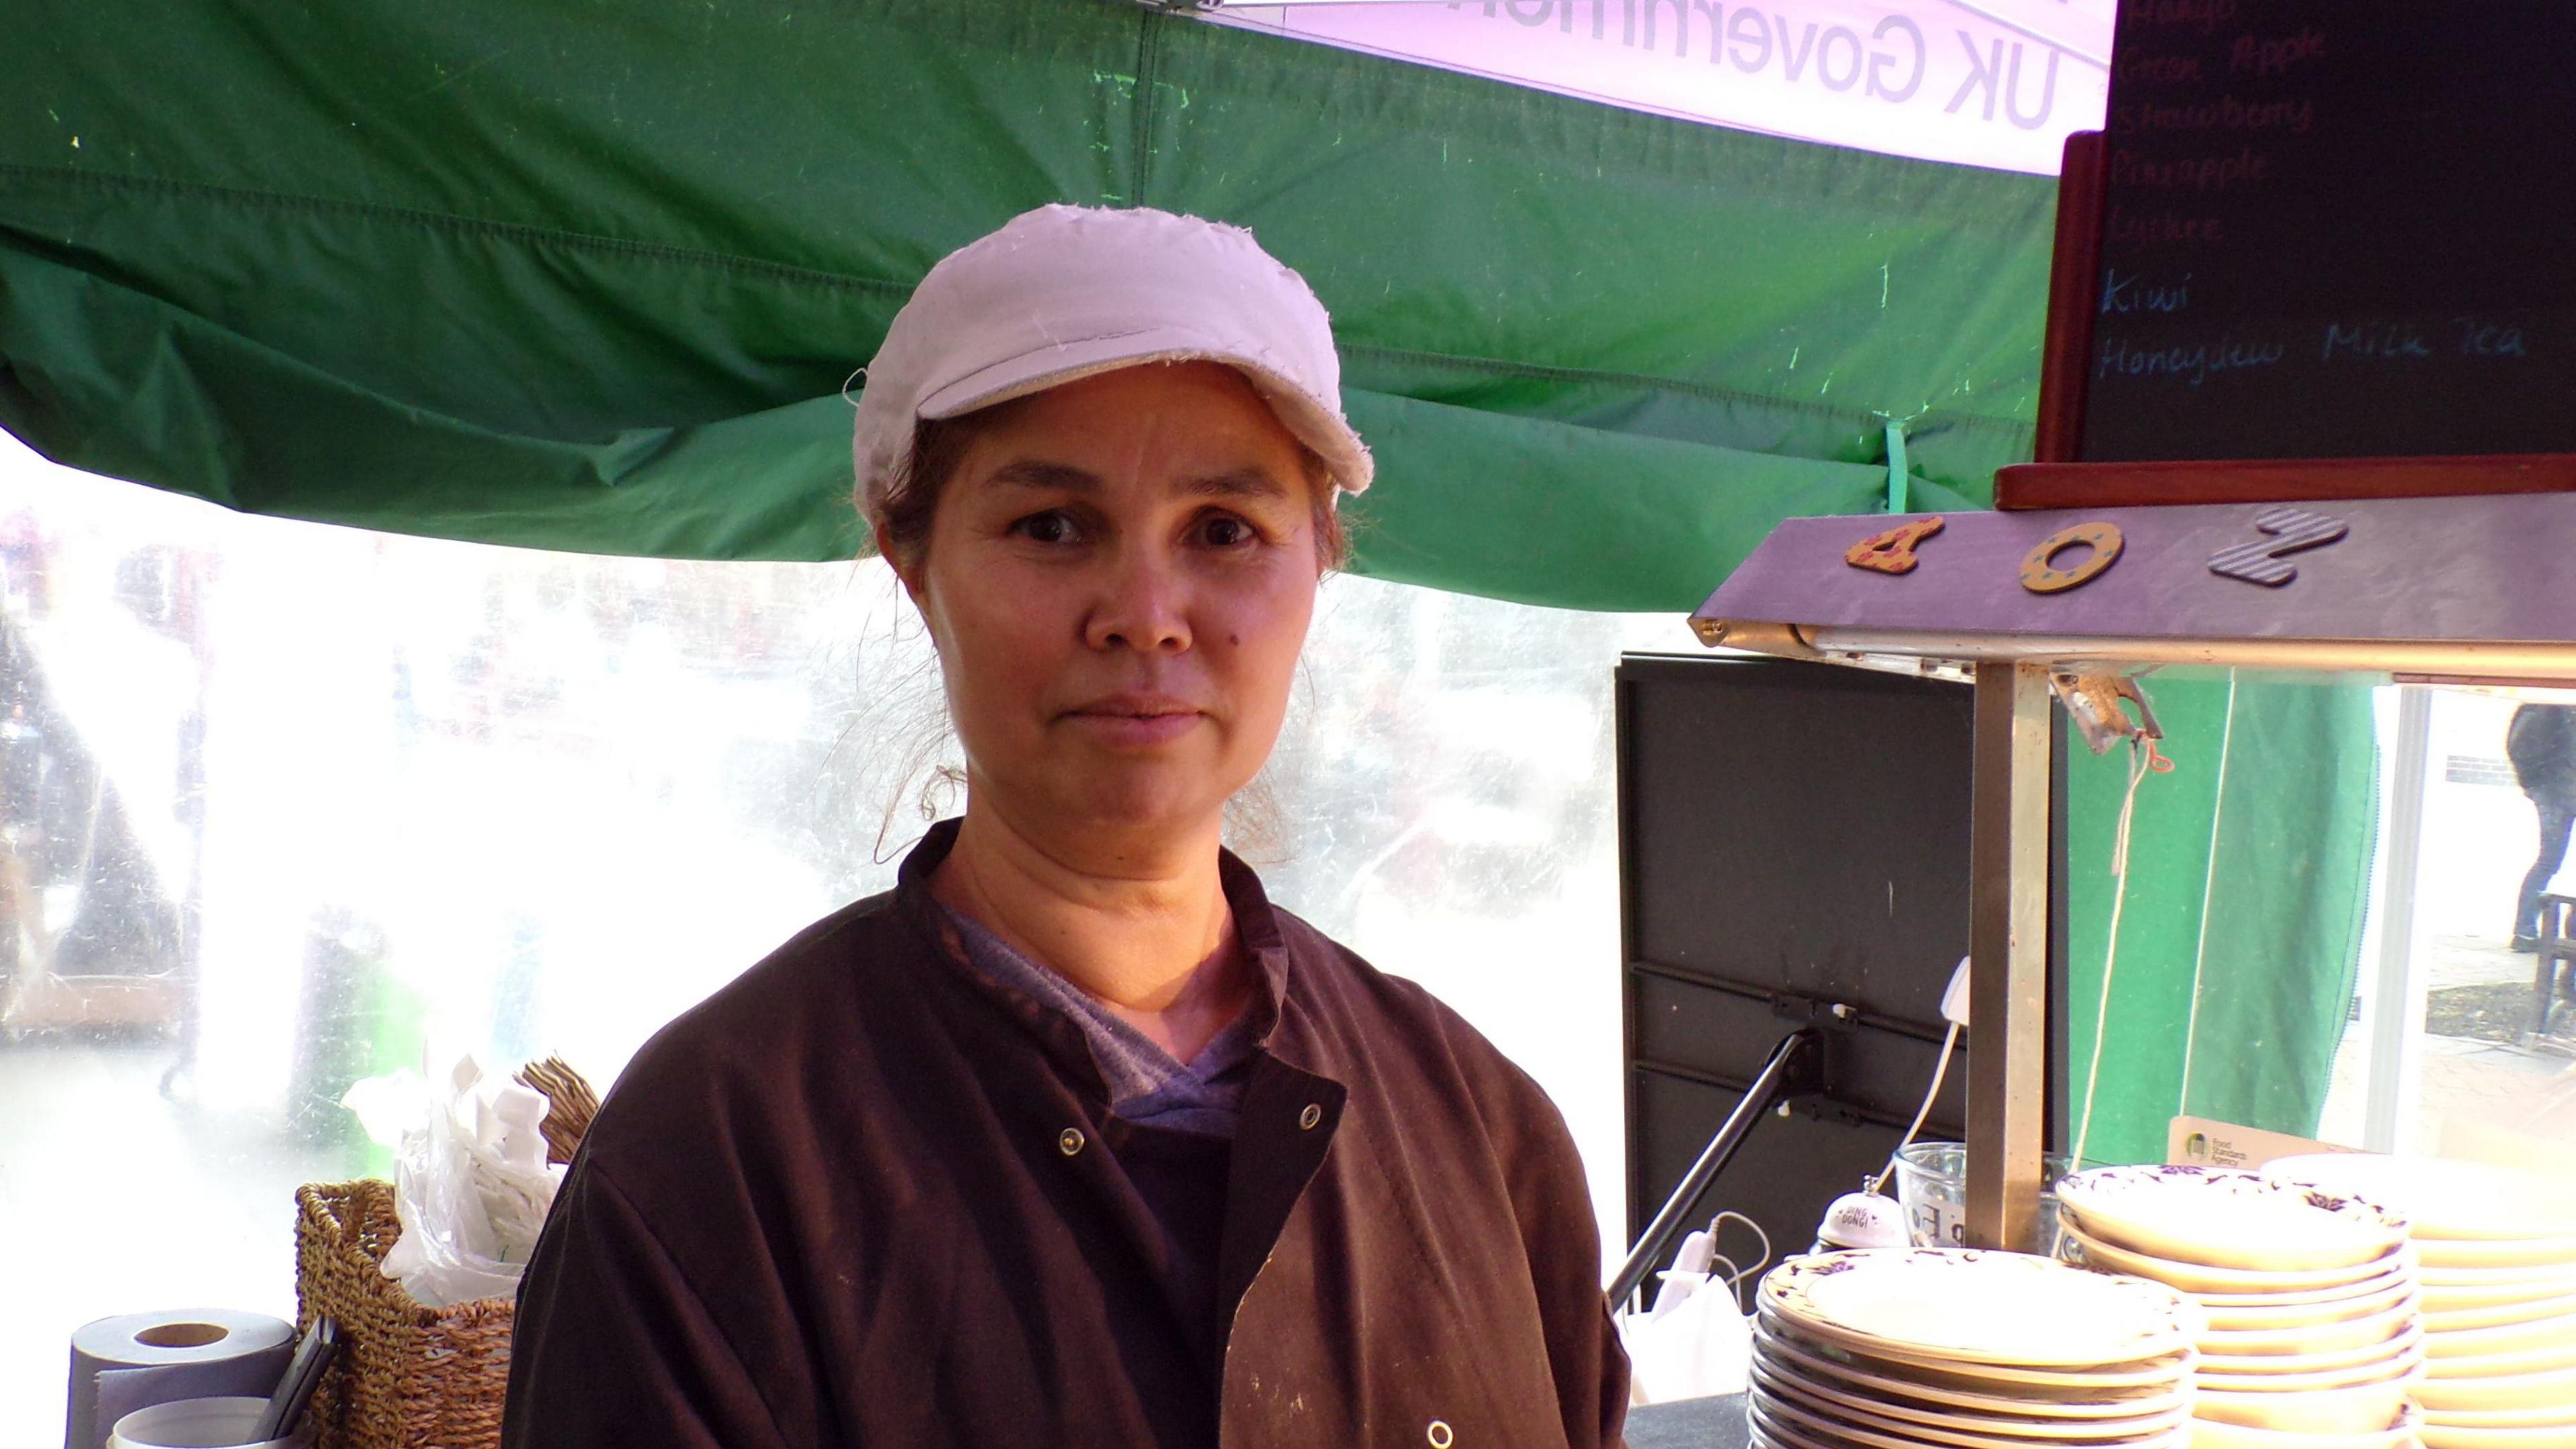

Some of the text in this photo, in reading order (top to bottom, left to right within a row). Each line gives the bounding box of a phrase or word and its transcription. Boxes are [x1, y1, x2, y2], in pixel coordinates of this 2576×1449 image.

[2231, 27, 2328, 76] Apple
[2101, 268, 2192, 314] Kiwi
[2099, 335, 2284, 386] Honeydew
[2450, 315, 2526, 356] Tea
[2212, 1137, 2232, 1149] Food
[2212, 1146, 2247, 1161] Standards
[2211, 1155, 2239, 1169] Agency
